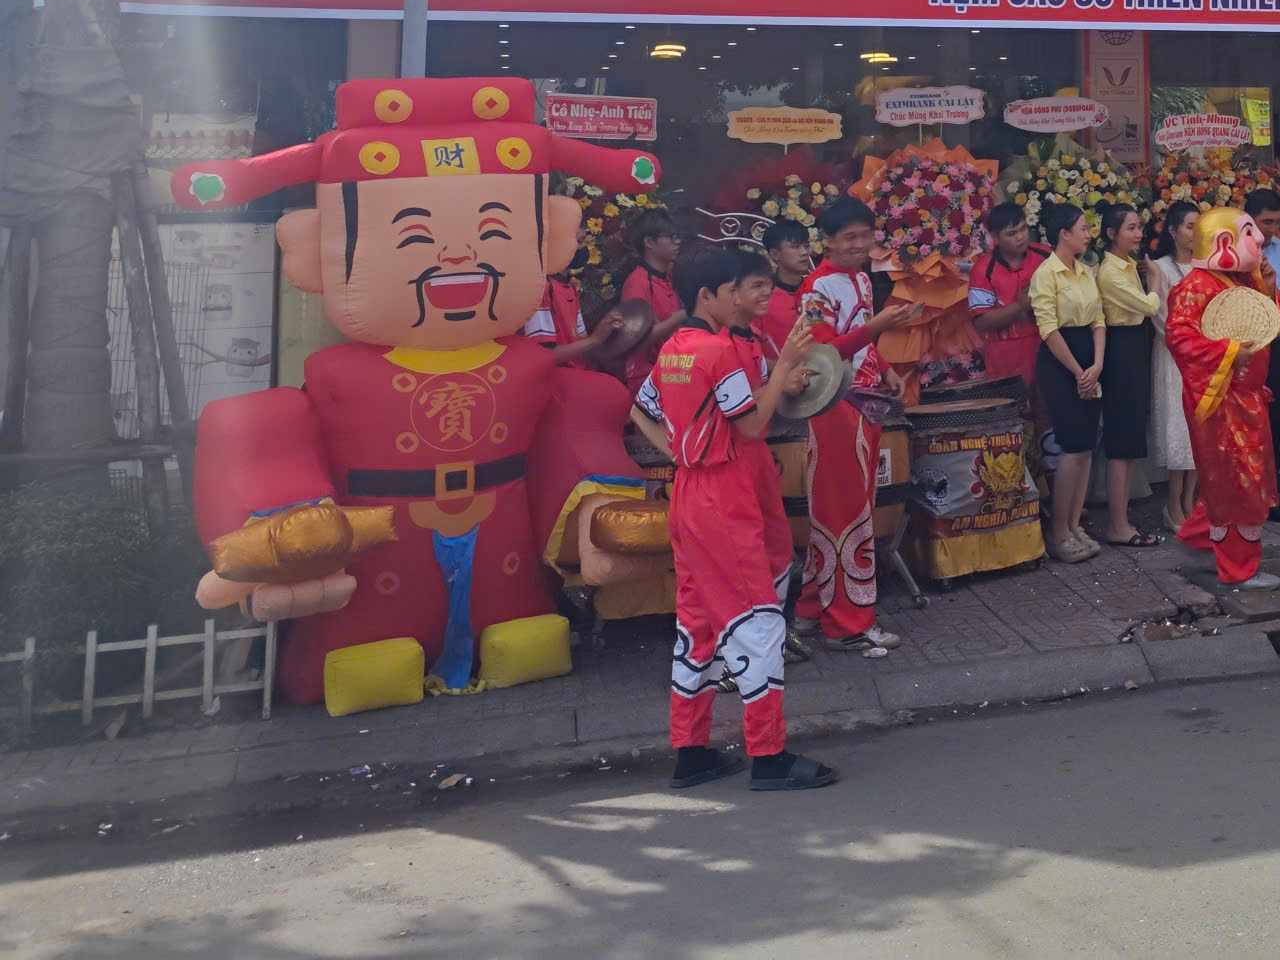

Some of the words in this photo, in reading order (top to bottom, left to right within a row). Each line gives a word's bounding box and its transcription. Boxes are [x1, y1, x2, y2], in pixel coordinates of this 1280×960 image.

[551, 103, 568, 117] Cô
[627, 103, 652, 119] Tiến
[434, 142, 465, 169] 财
